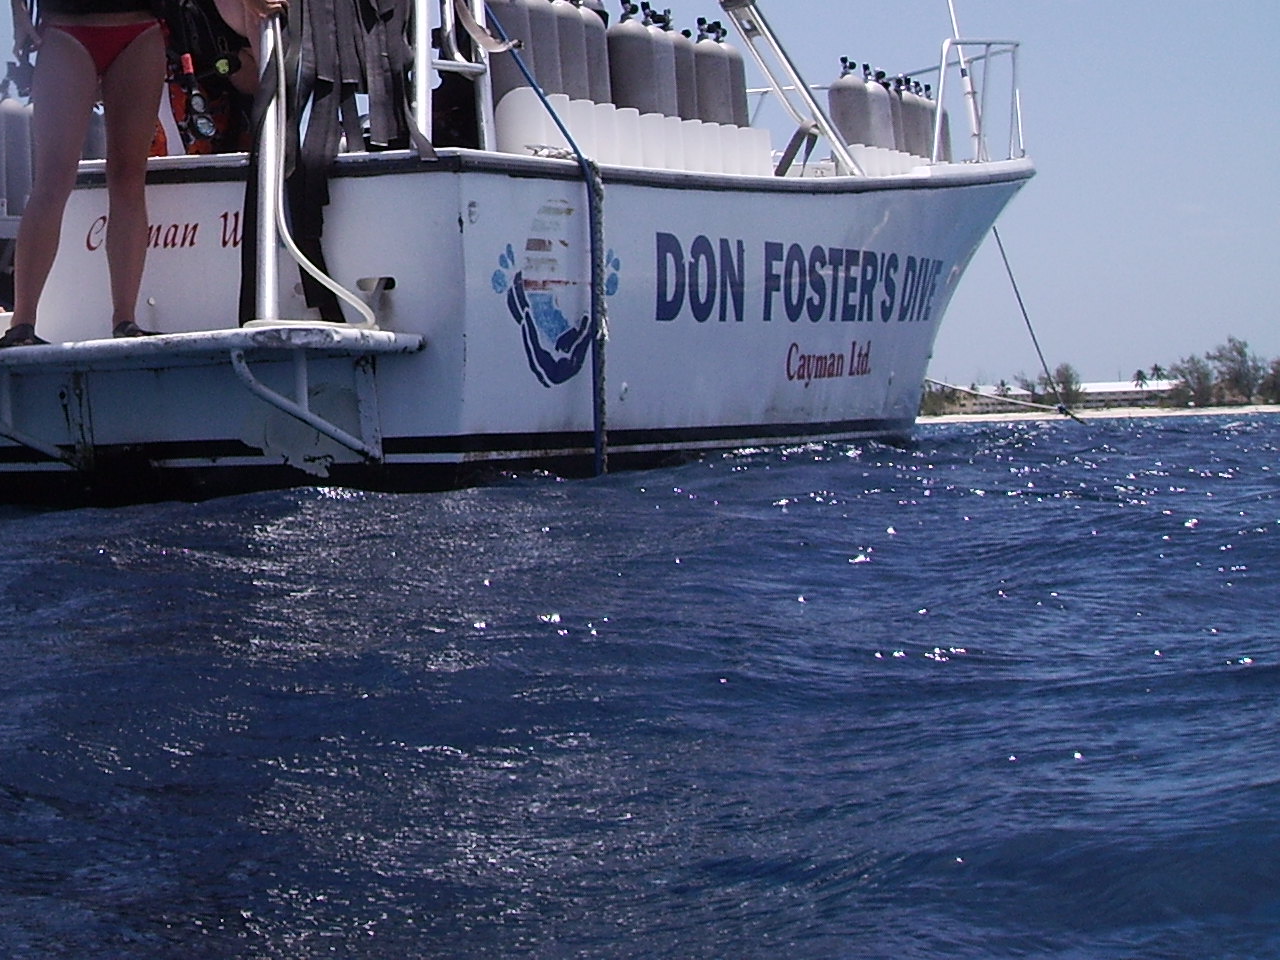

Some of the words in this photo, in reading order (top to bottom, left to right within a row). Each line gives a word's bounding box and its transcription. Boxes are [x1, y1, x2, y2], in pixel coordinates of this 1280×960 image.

[85, 215, 199, 252] Cman
[655, 231, 745, 322] DON
[762, 241, 900, 323] FOSTER'S
[897, 255, 944, 322] DIVE
[785, 341, 844, 389] Cayman
[848, 340, 872, 376] Ltd.
